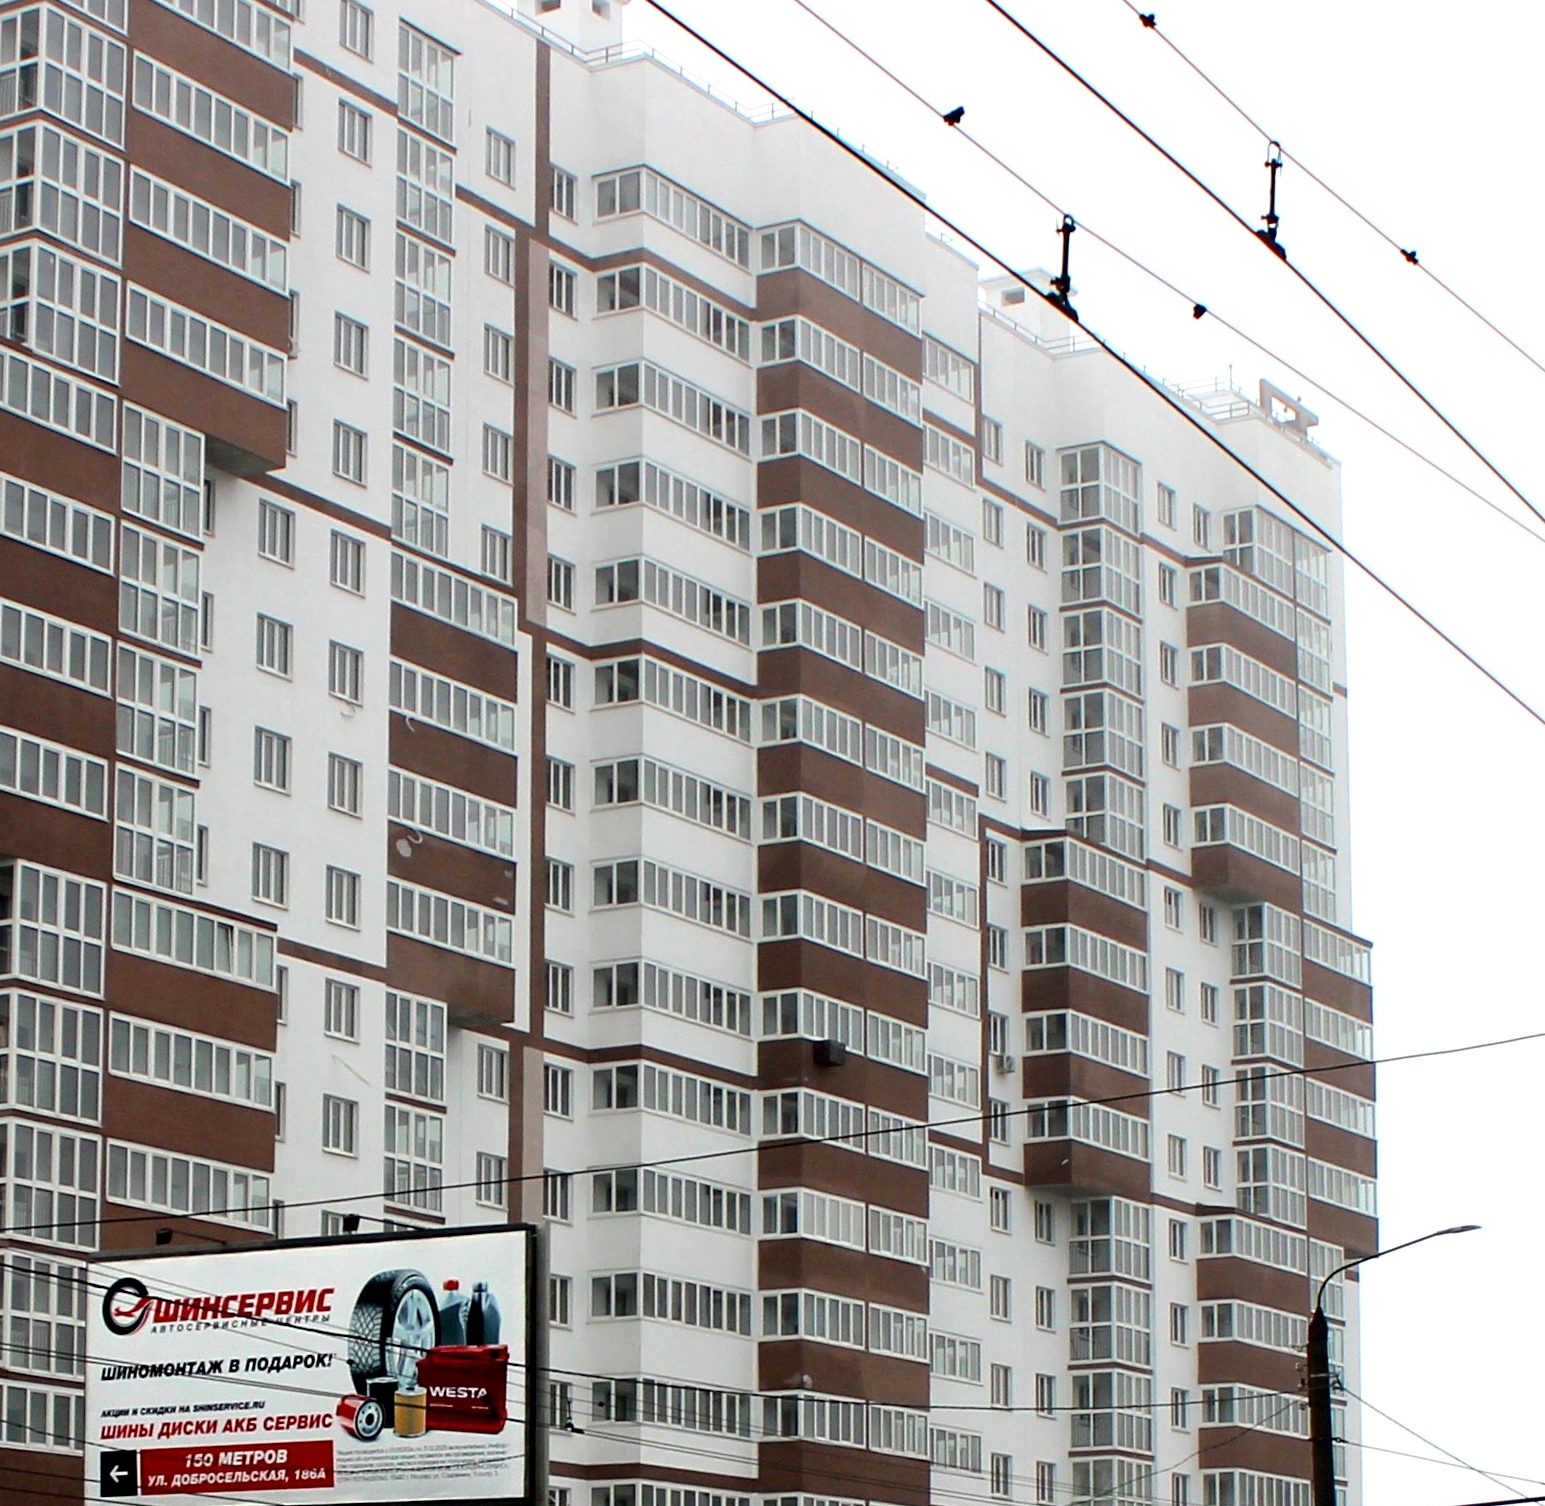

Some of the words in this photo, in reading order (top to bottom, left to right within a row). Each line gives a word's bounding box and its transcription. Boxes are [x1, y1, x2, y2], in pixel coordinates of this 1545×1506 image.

[152, 1286, 336, 1324] ШИНСЕРВИС
[151, 1317, 268, 1334] АВТОСЕРВИСНЫЕ
[274, 1314, 331, 1325] ЦЕНТРЫ
[100, 1360, 223, 1381] ШИНОМОНТАЖ
[228, 1358, 240, 1373] В
[245, 1353, 333, 1374] ПОДАРОК!
[428, 1386, 488, 1400] WESTA
[100, 1409, 129, 1418] АКЦИИ
[140, 1406, 176, 1416] СКИДКИ
[178, 1405, 190, 1413] НА
[192, 1401, 265, 1413] SHINSERVICE.RU
[100, 1422, 154, 1440] ШИНЫ
[157, 1419, 218, 1439] ДИСКИ
[222, 1417, 258, 1434] АКБ
[263, 1413, 333, 1431] СЕРВИС
[185, 1453, 214, 1468] 150
[218, 1449, 288, 1467] МЕТРОВ
[148, 1475, 168, 1487] УЛ.
[171, 1469, 289, 1488] ДОБРОСЕЛЬСКАЯ,
